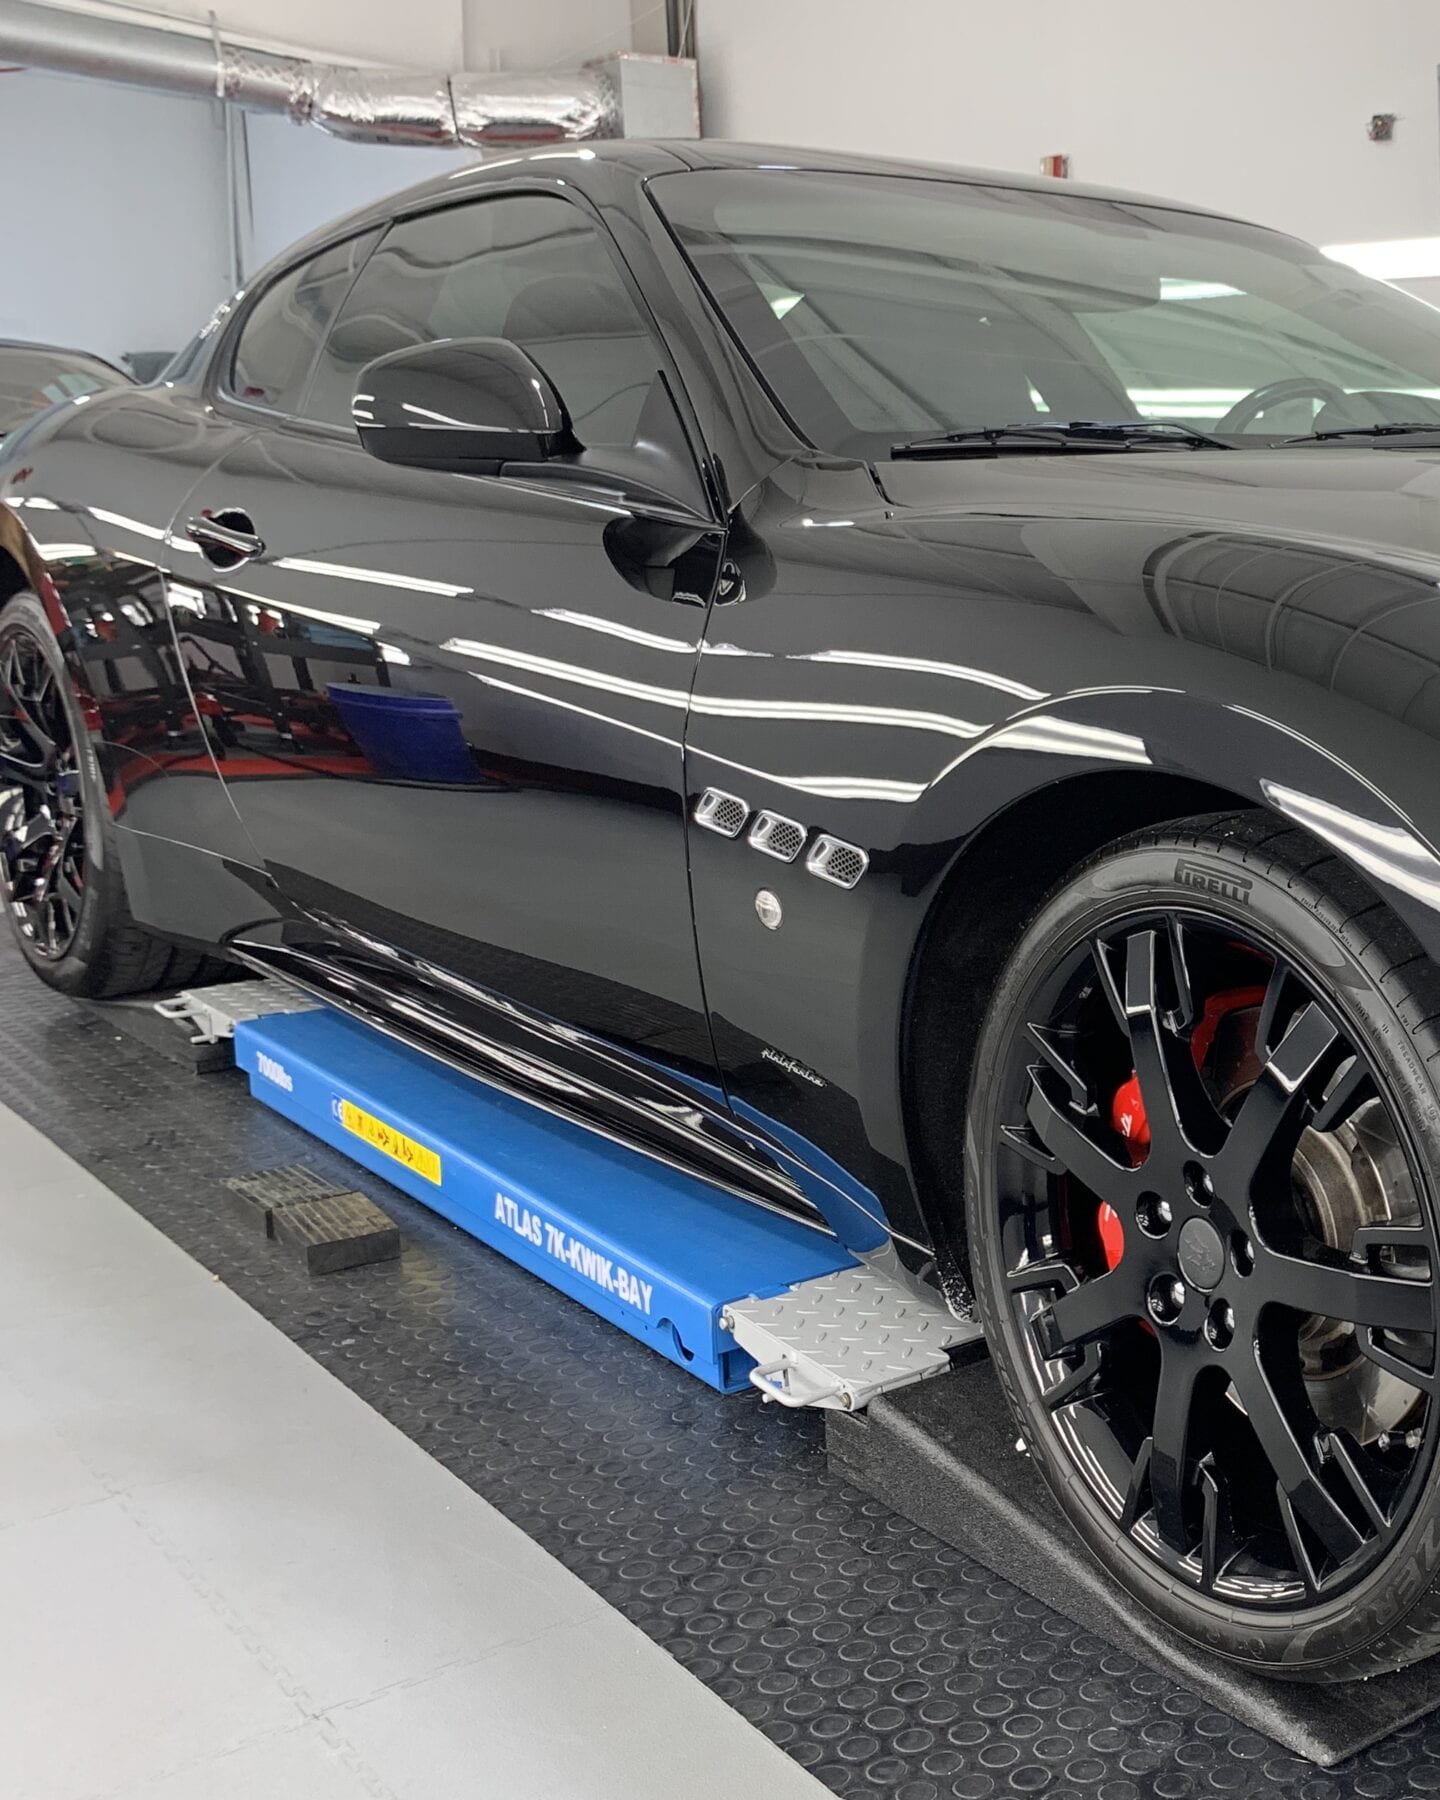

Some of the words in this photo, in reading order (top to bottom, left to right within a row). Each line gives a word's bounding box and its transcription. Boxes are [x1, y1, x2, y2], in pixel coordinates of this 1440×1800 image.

[1173, 858, 1254, 907] PIRELLI
[1397, 1042, 1427, 1095] TREADWEAR
[495, 1192, 542, 1247] ATLAS
[545, 1222, 653, 1316] 7K-KWIK-BAY
